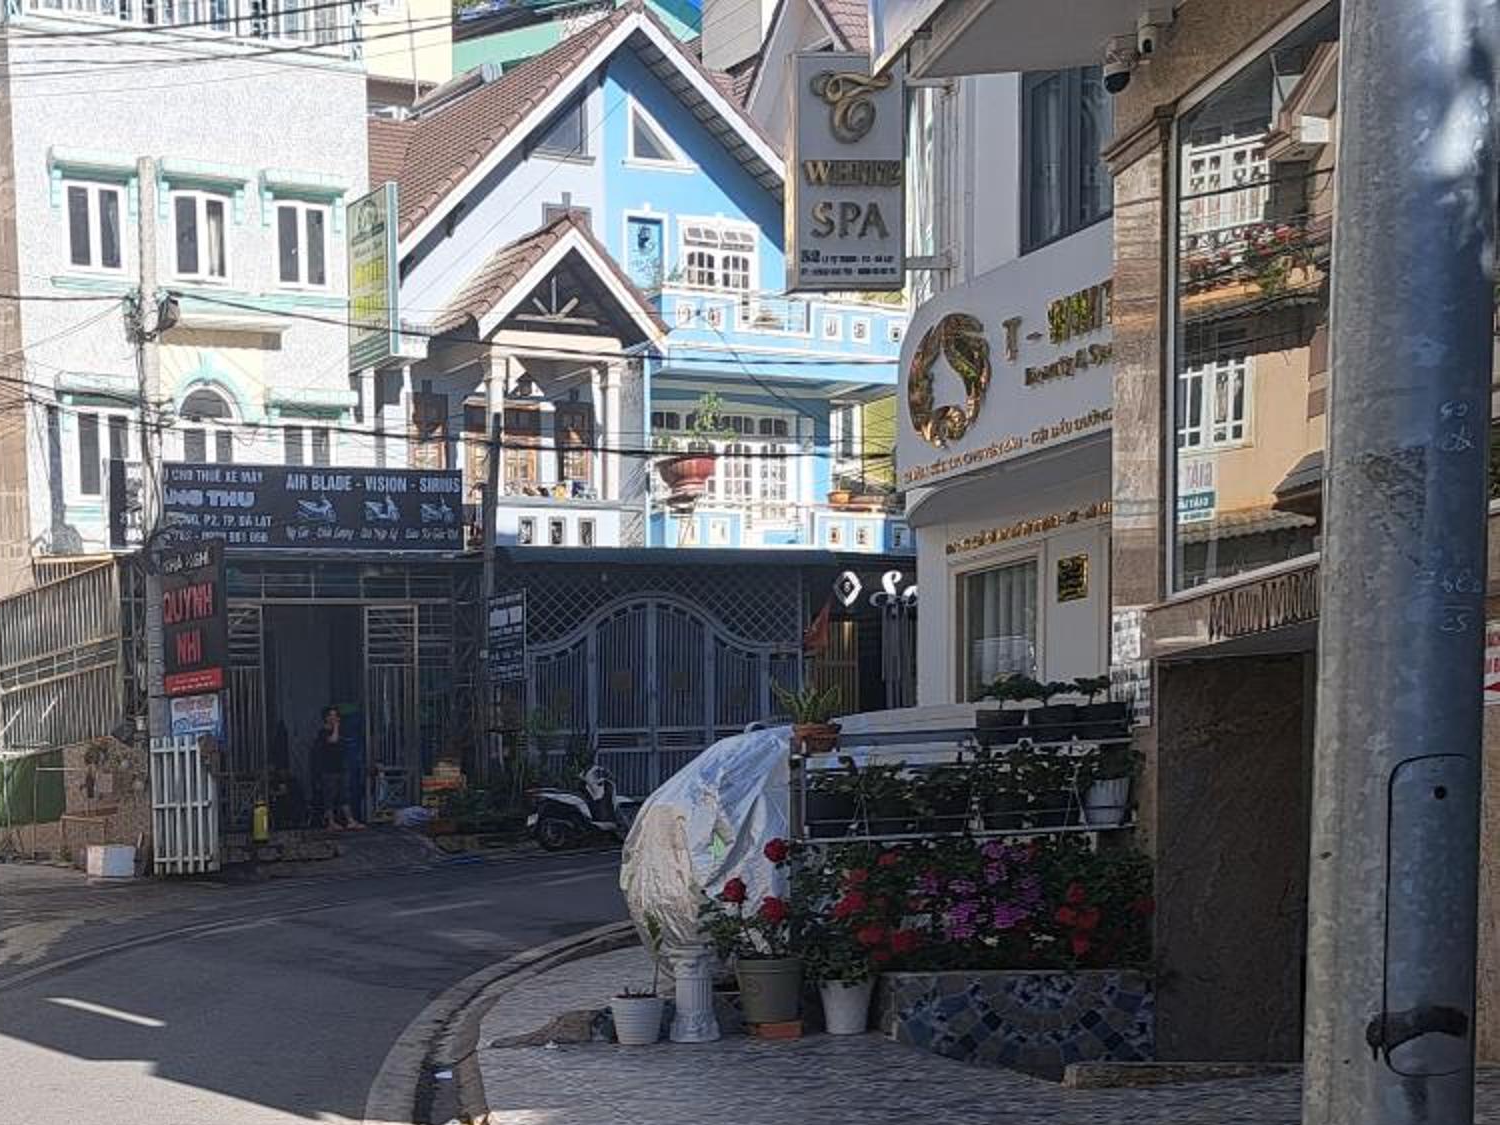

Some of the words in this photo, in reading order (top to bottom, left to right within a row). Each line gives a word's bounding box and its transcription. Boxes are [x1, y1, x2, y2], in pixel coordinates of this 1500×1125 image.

[811, 201, 889, 240] SPA
[285, 473, 308, 491] AIR
[311, 474, 353, 491] BLADE
[365, 475, 407, 493] VISION
[419, 477, 461, 493] SIRIUS
